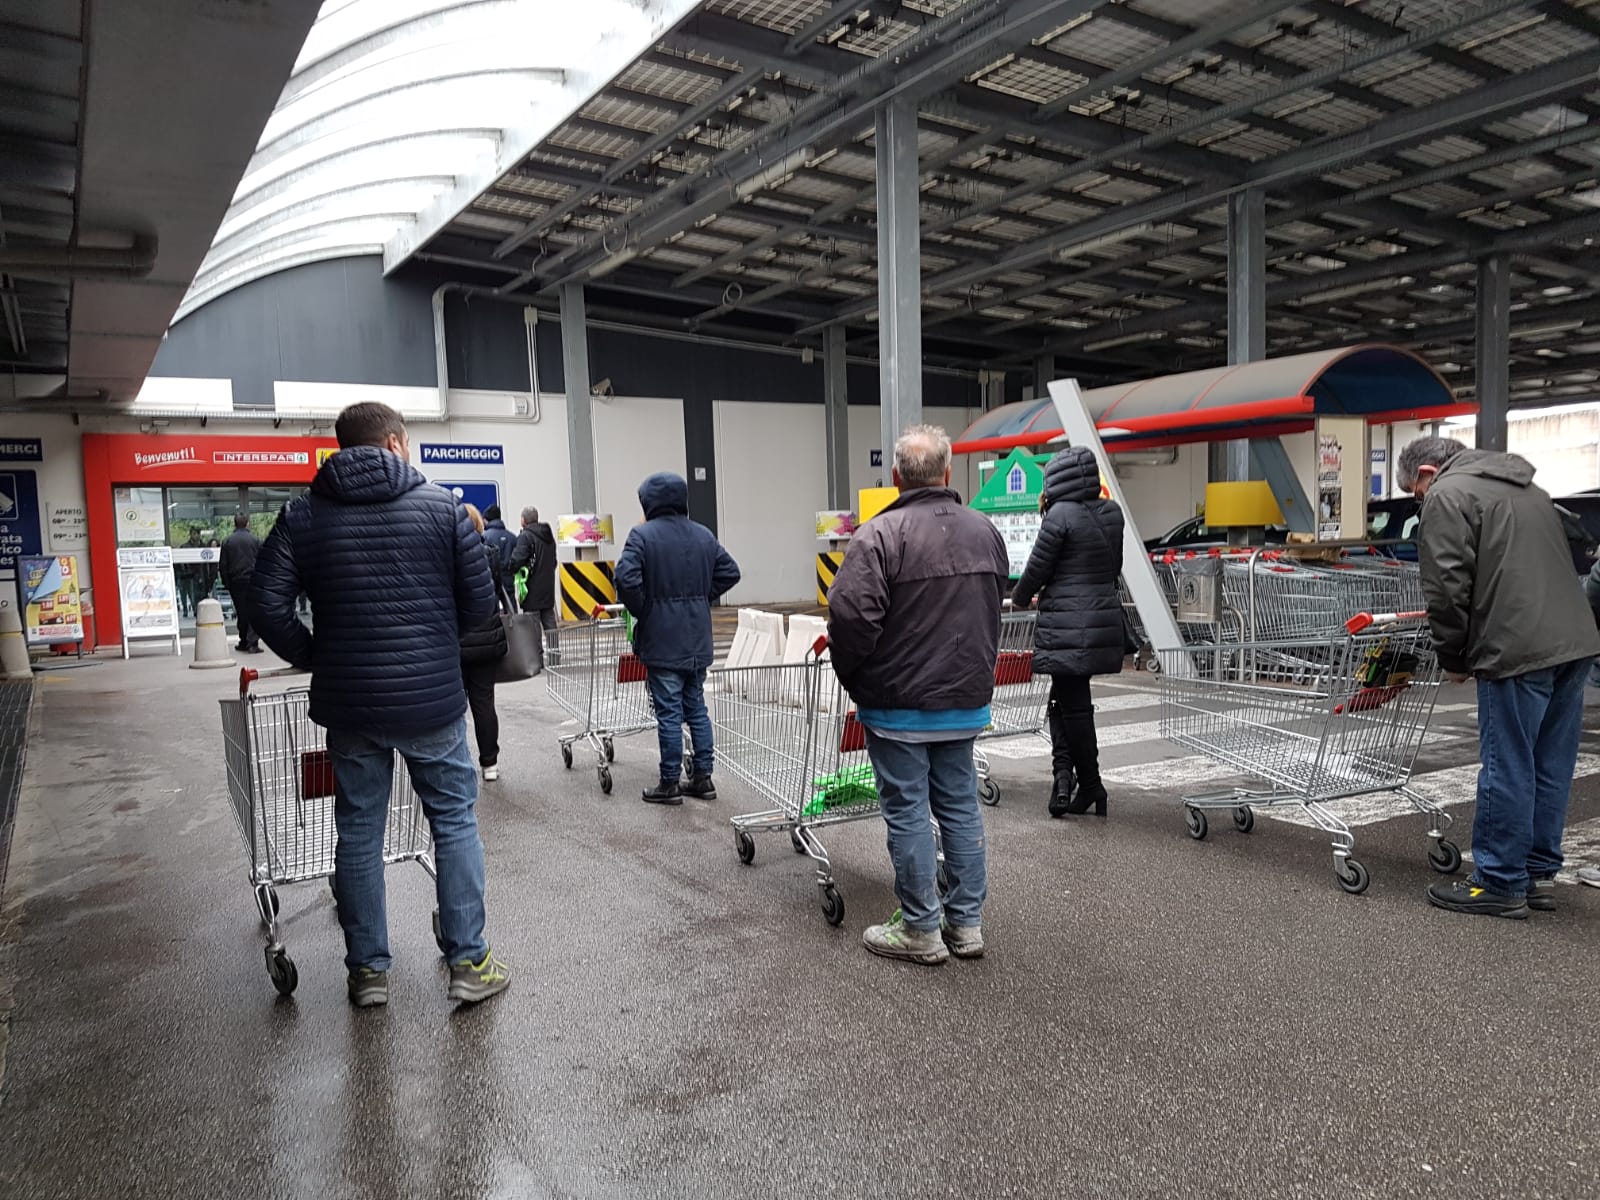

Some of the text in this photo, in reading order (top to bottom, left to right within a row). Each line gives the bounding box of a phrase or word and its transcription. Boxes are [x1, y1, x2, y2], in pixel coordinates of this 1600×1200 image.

[134, 447, 195, 465] Benvenuti!
[223, 453, 295, 463] INTERSPAR
[424, 447, 500, 460] PARCHEGGIO
